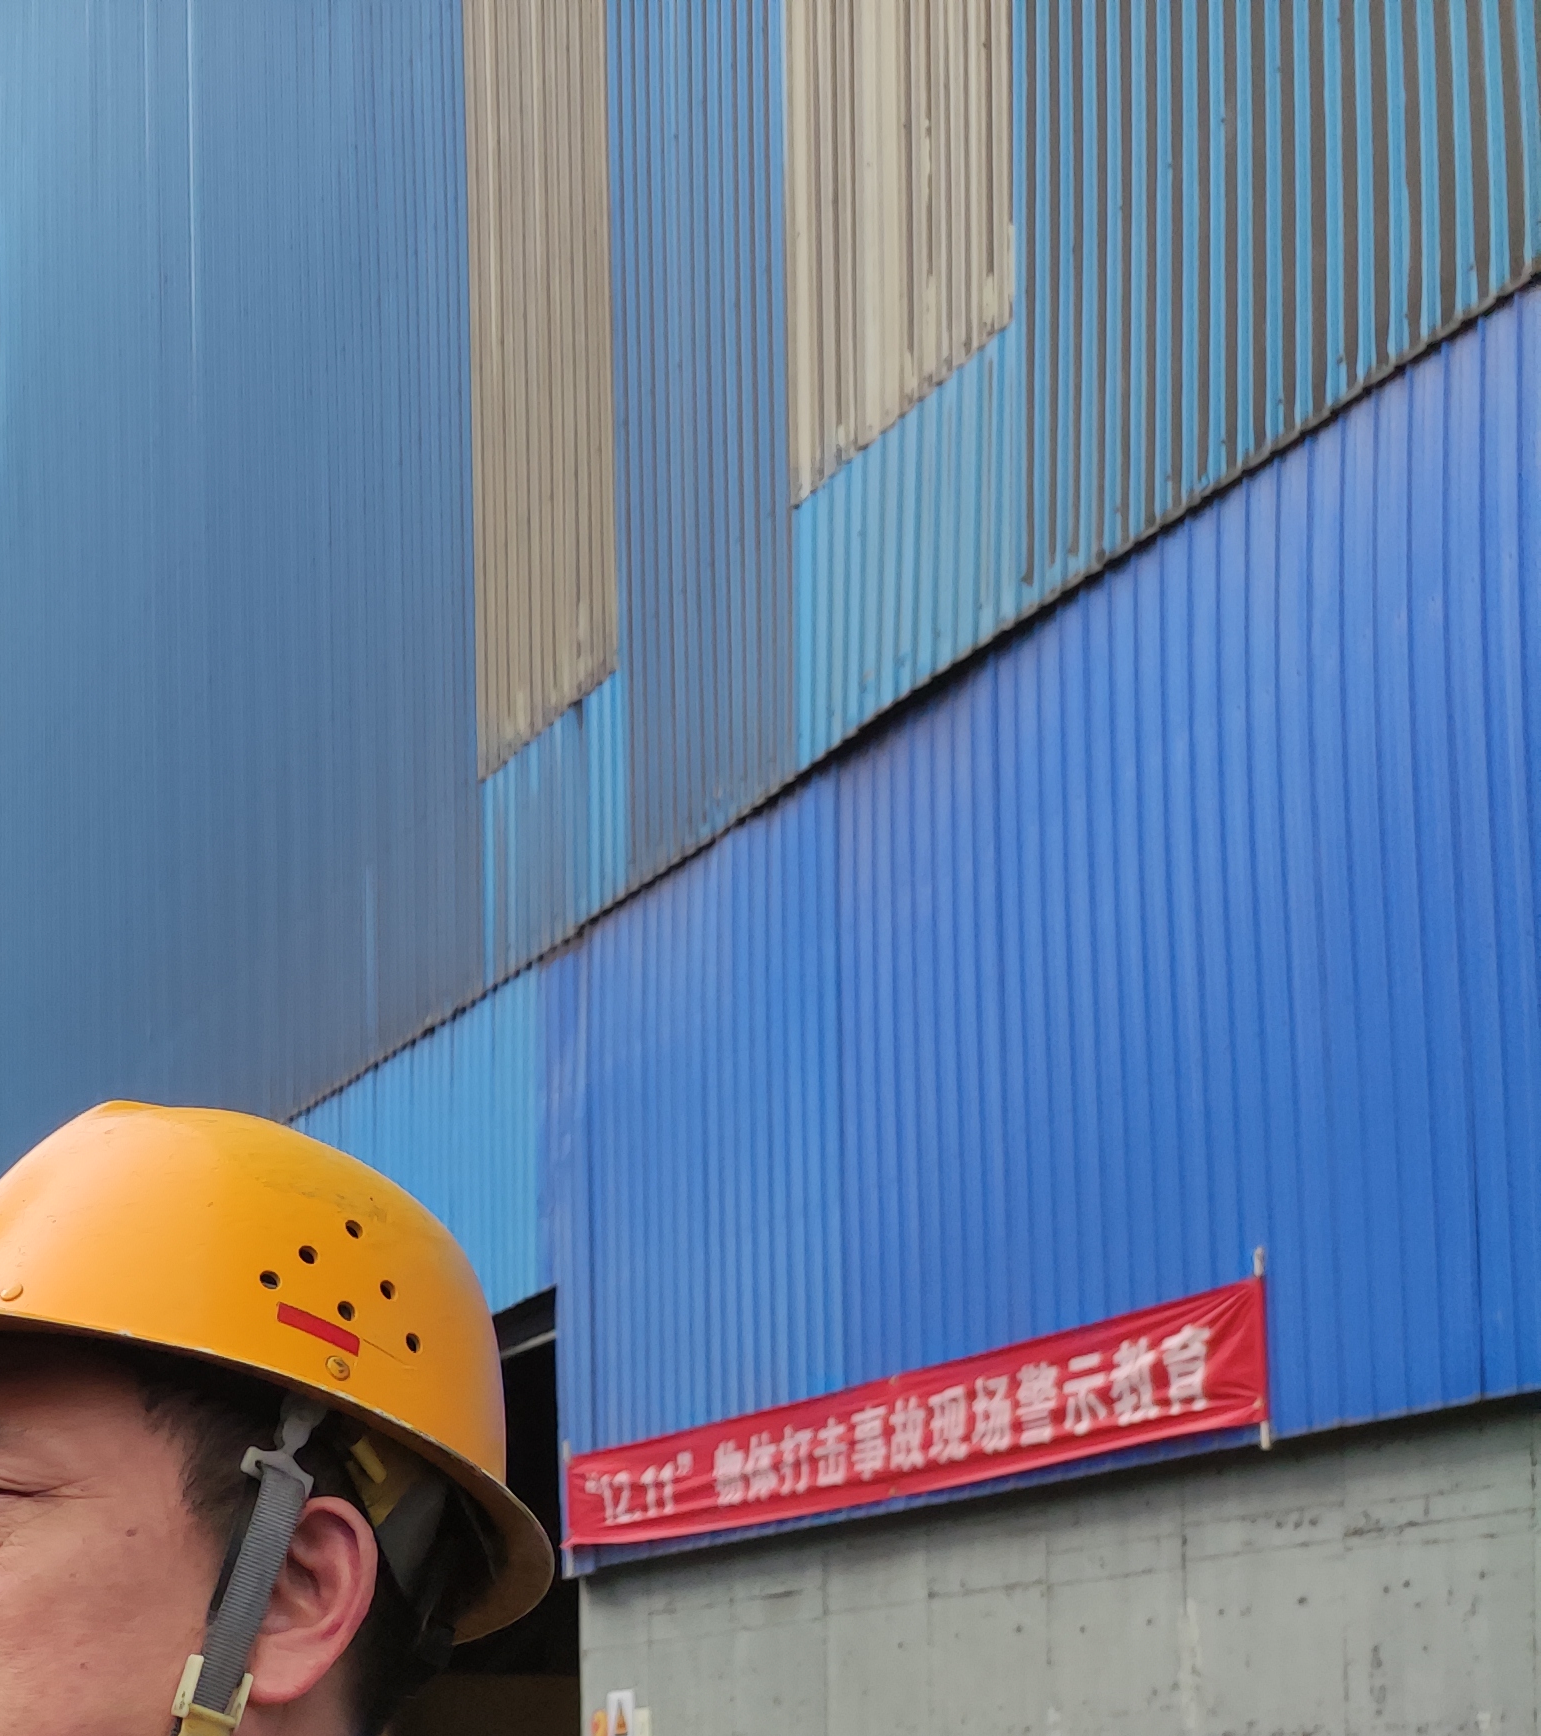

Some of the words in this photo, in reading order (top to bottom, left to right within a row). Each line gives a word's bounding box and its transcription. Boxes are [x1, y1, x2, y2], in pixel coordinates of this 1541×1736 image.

[713, 1323, 1211, 1507] 物体打击事故现场警示教育
